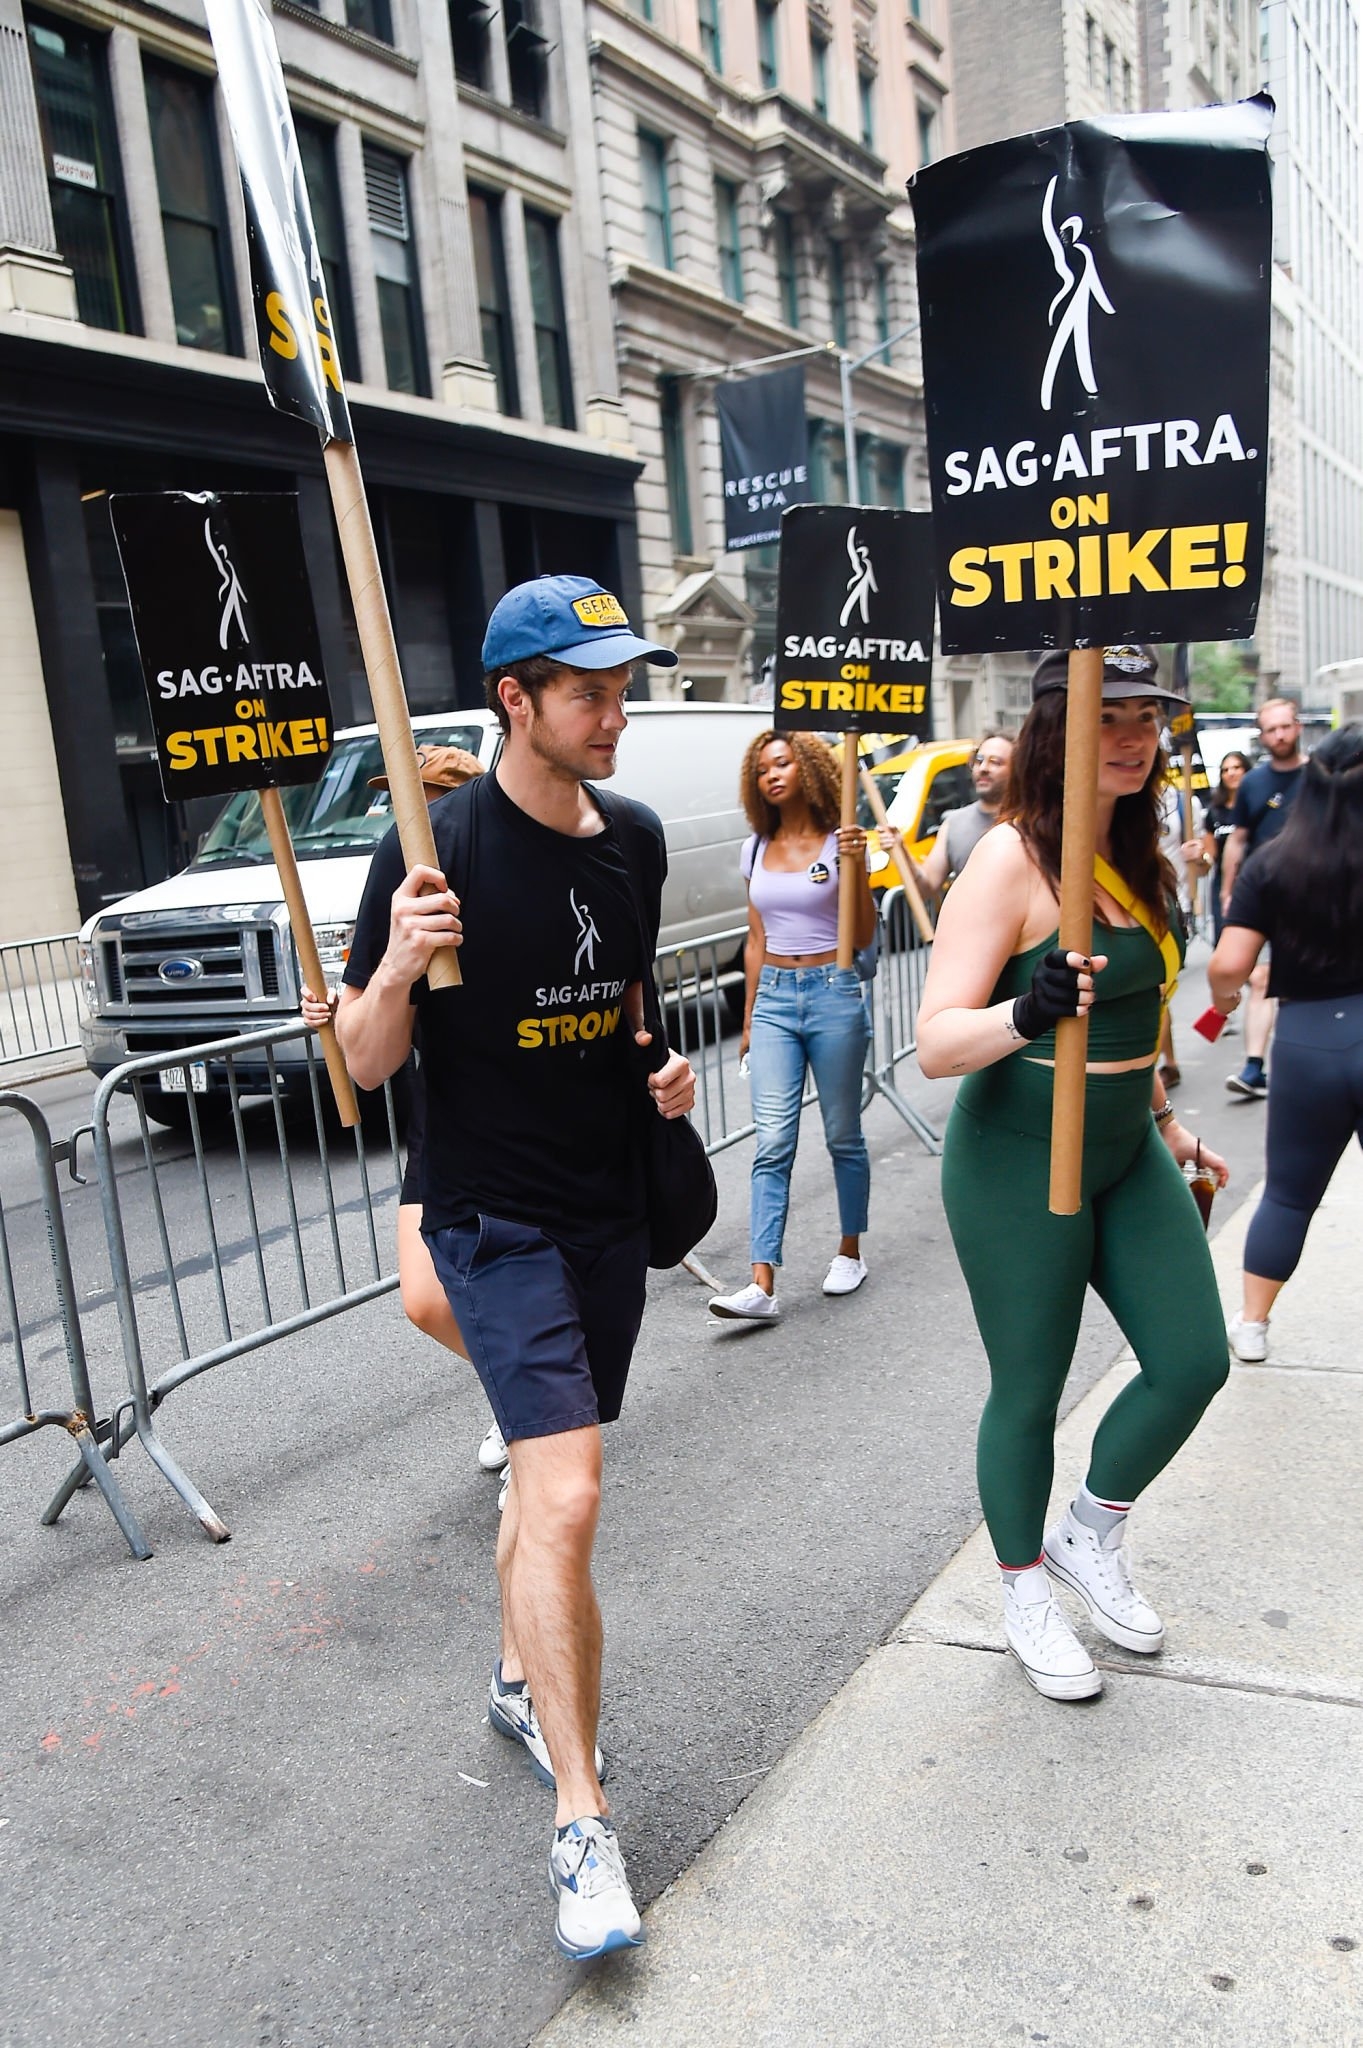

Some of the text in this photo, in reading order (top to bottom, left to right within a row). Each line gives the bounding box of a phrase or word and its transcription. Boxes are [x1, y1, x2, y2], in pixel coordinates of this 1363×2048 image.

[725, 465, 808, 497] RESCUE
[747, 490, 787, 512] SPA
[1050, 492, 1109, 530] ON
[948, 522, 1248, 607] STRIKE!
[840, 663, 871, 680] ON
[235, 698, 266, 719] ON
[780, 680, 926, 714] STRIKE!
[166, 717, 329, 770] STRIKE!
[517, 1005, 621, 1048] STRON
